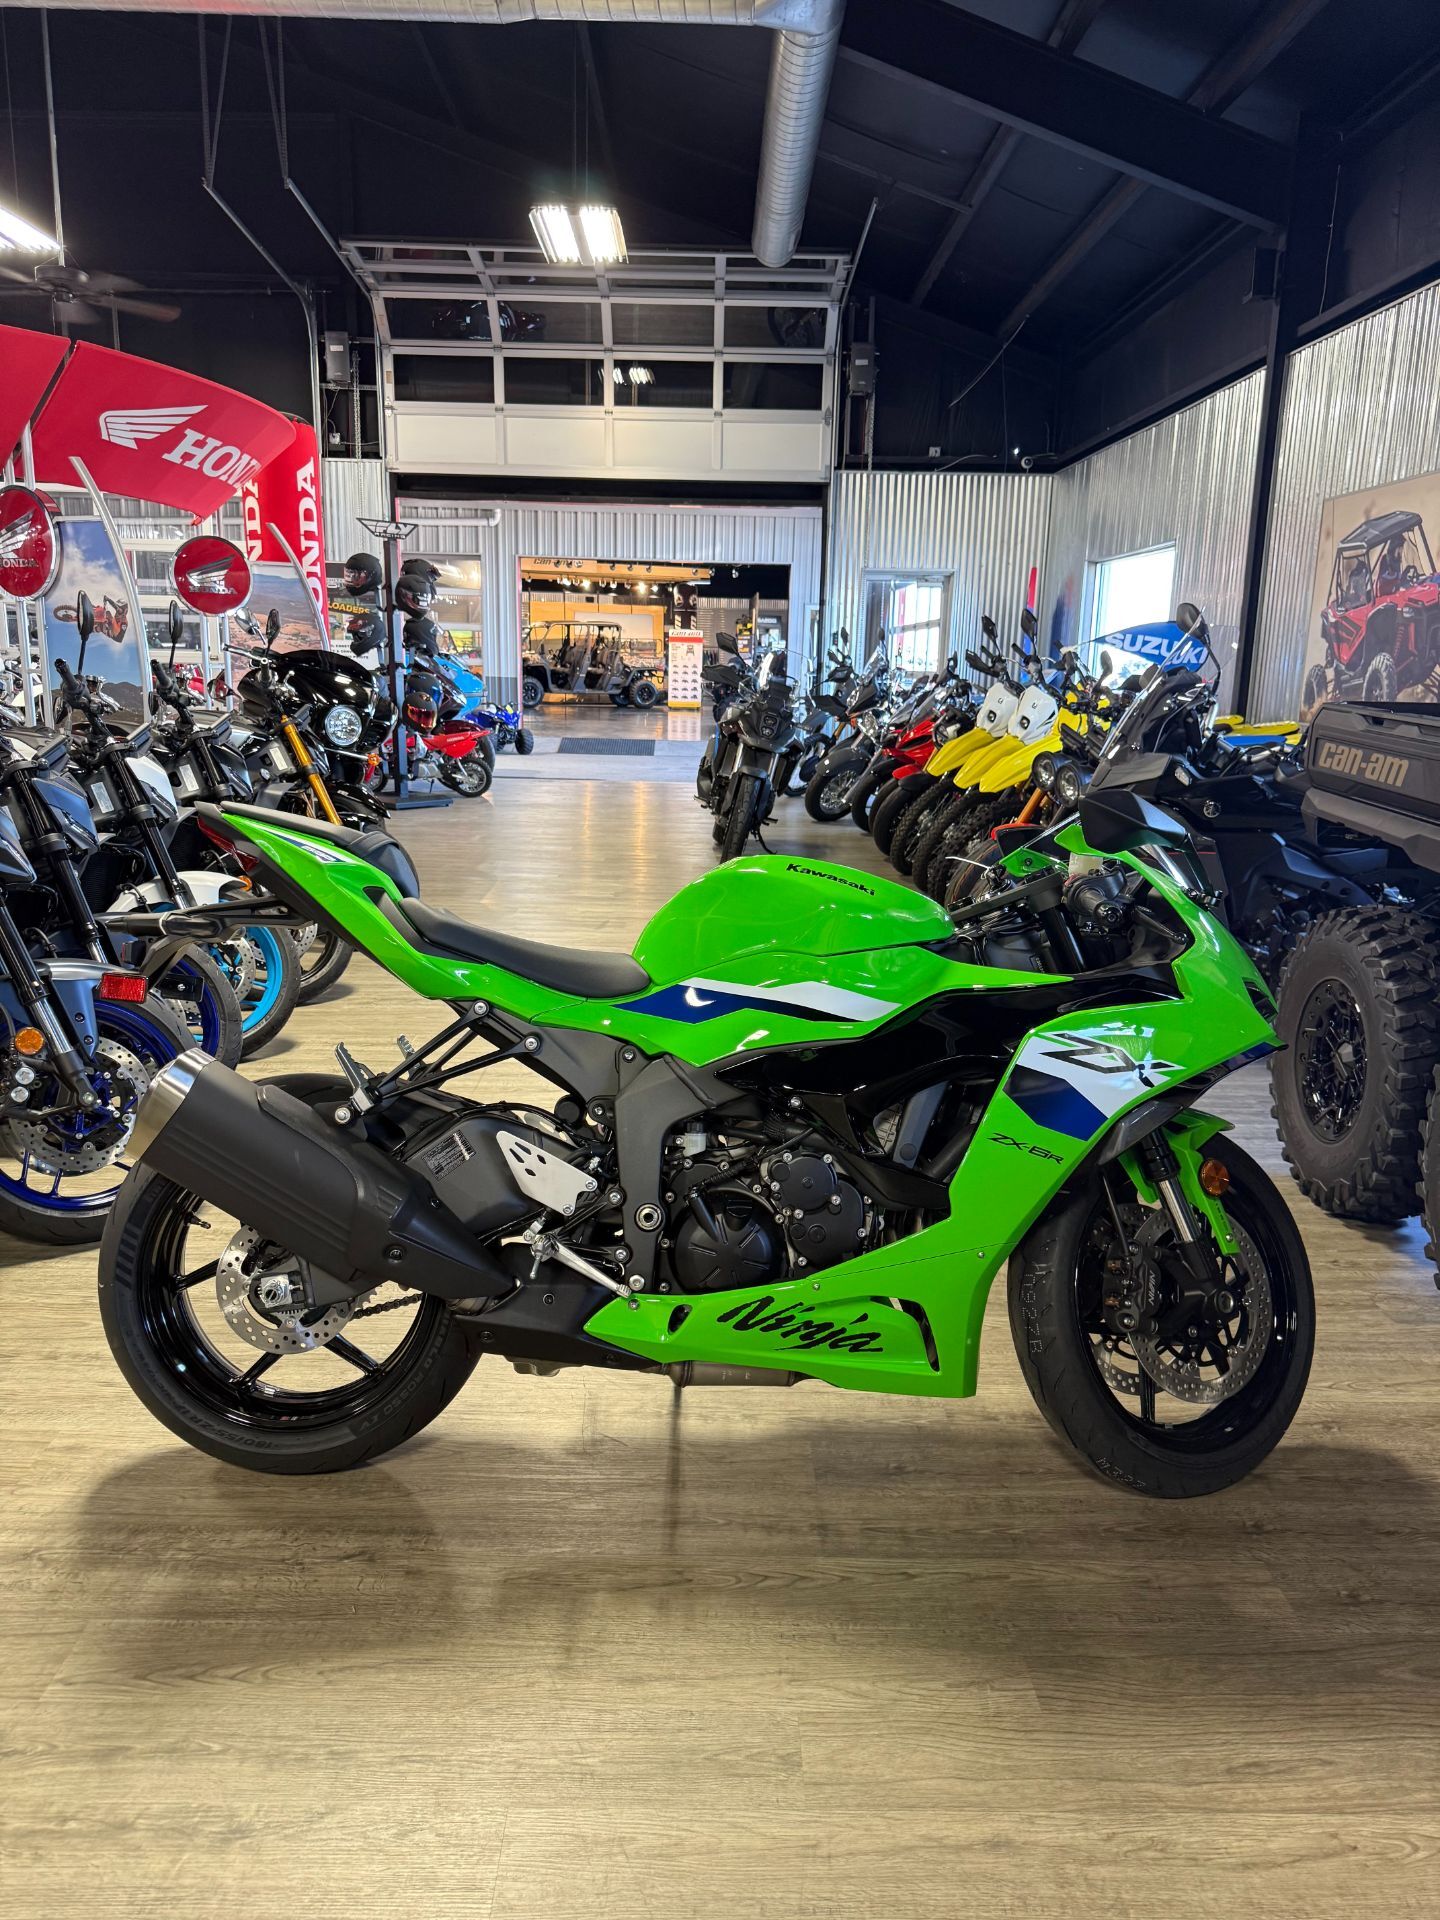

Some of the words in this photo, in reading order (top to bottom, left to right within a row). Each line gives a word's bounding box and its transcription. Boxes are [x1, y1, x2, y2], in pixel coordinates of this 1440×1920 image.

[296, 456, 324, 619] ONDA
[0, 558, 40, 568] ONDA
[188, 585, 238, 595] HONDA
[1104, 633, 1209, 665] SUZUKI
[1318, 742, 1409, 787] can-am
[786, 863, 875, 896] Kawasaki
[986, 1132, 1064, 1165] ZX-6R
[716, 1295, 883, 1352] Ninja
